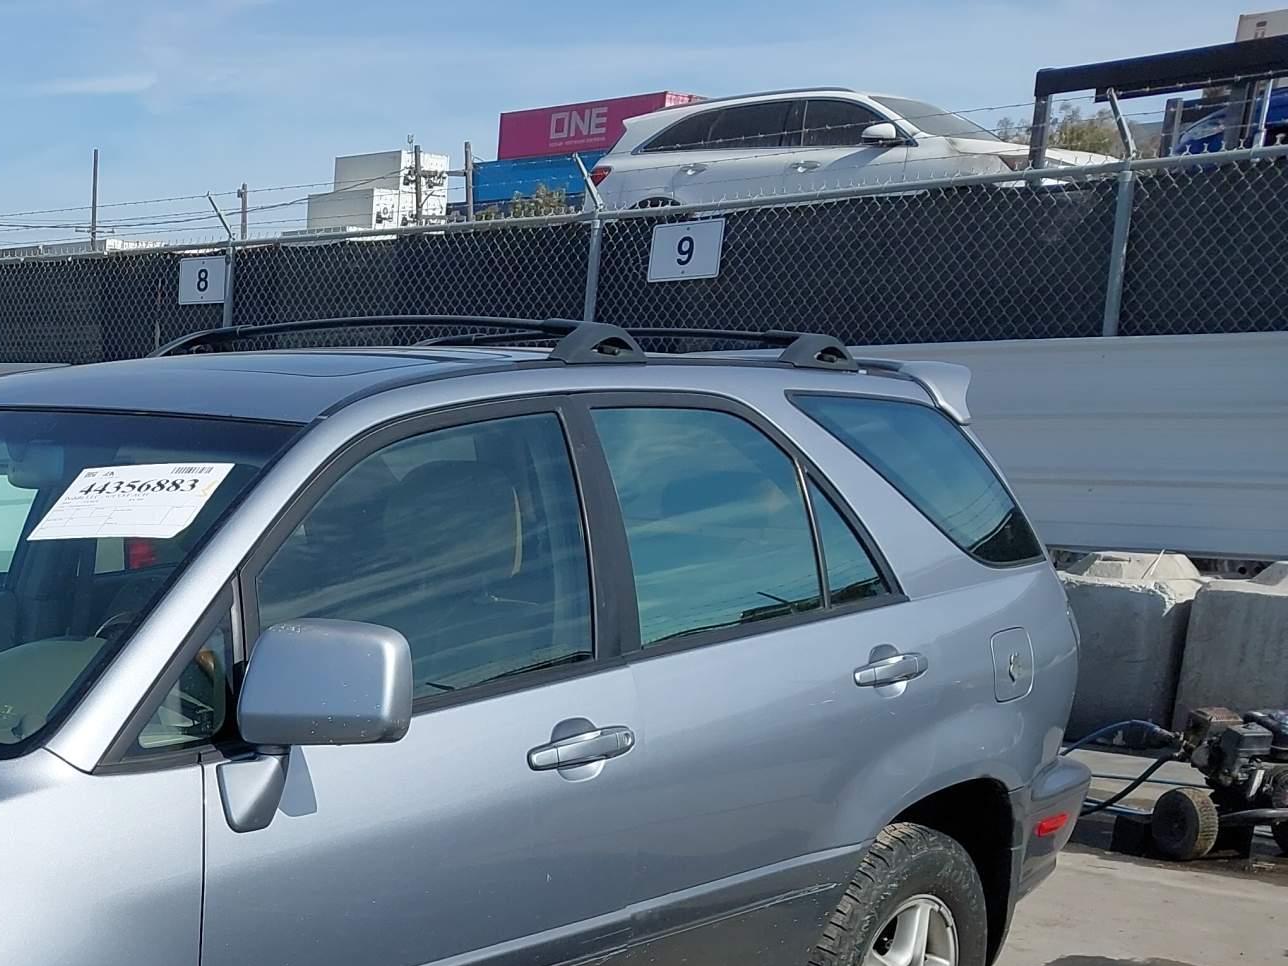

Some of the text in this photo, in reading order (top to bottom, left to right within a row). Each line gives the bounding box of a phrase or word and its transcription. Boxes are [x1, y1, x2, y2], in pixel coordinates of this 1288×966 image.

[549, 107, 608, 139] ONE
[676, 236, 695, 266] 9
[197, 268, 209, 292] 8
[78, 478, 200, 496] 44356883
